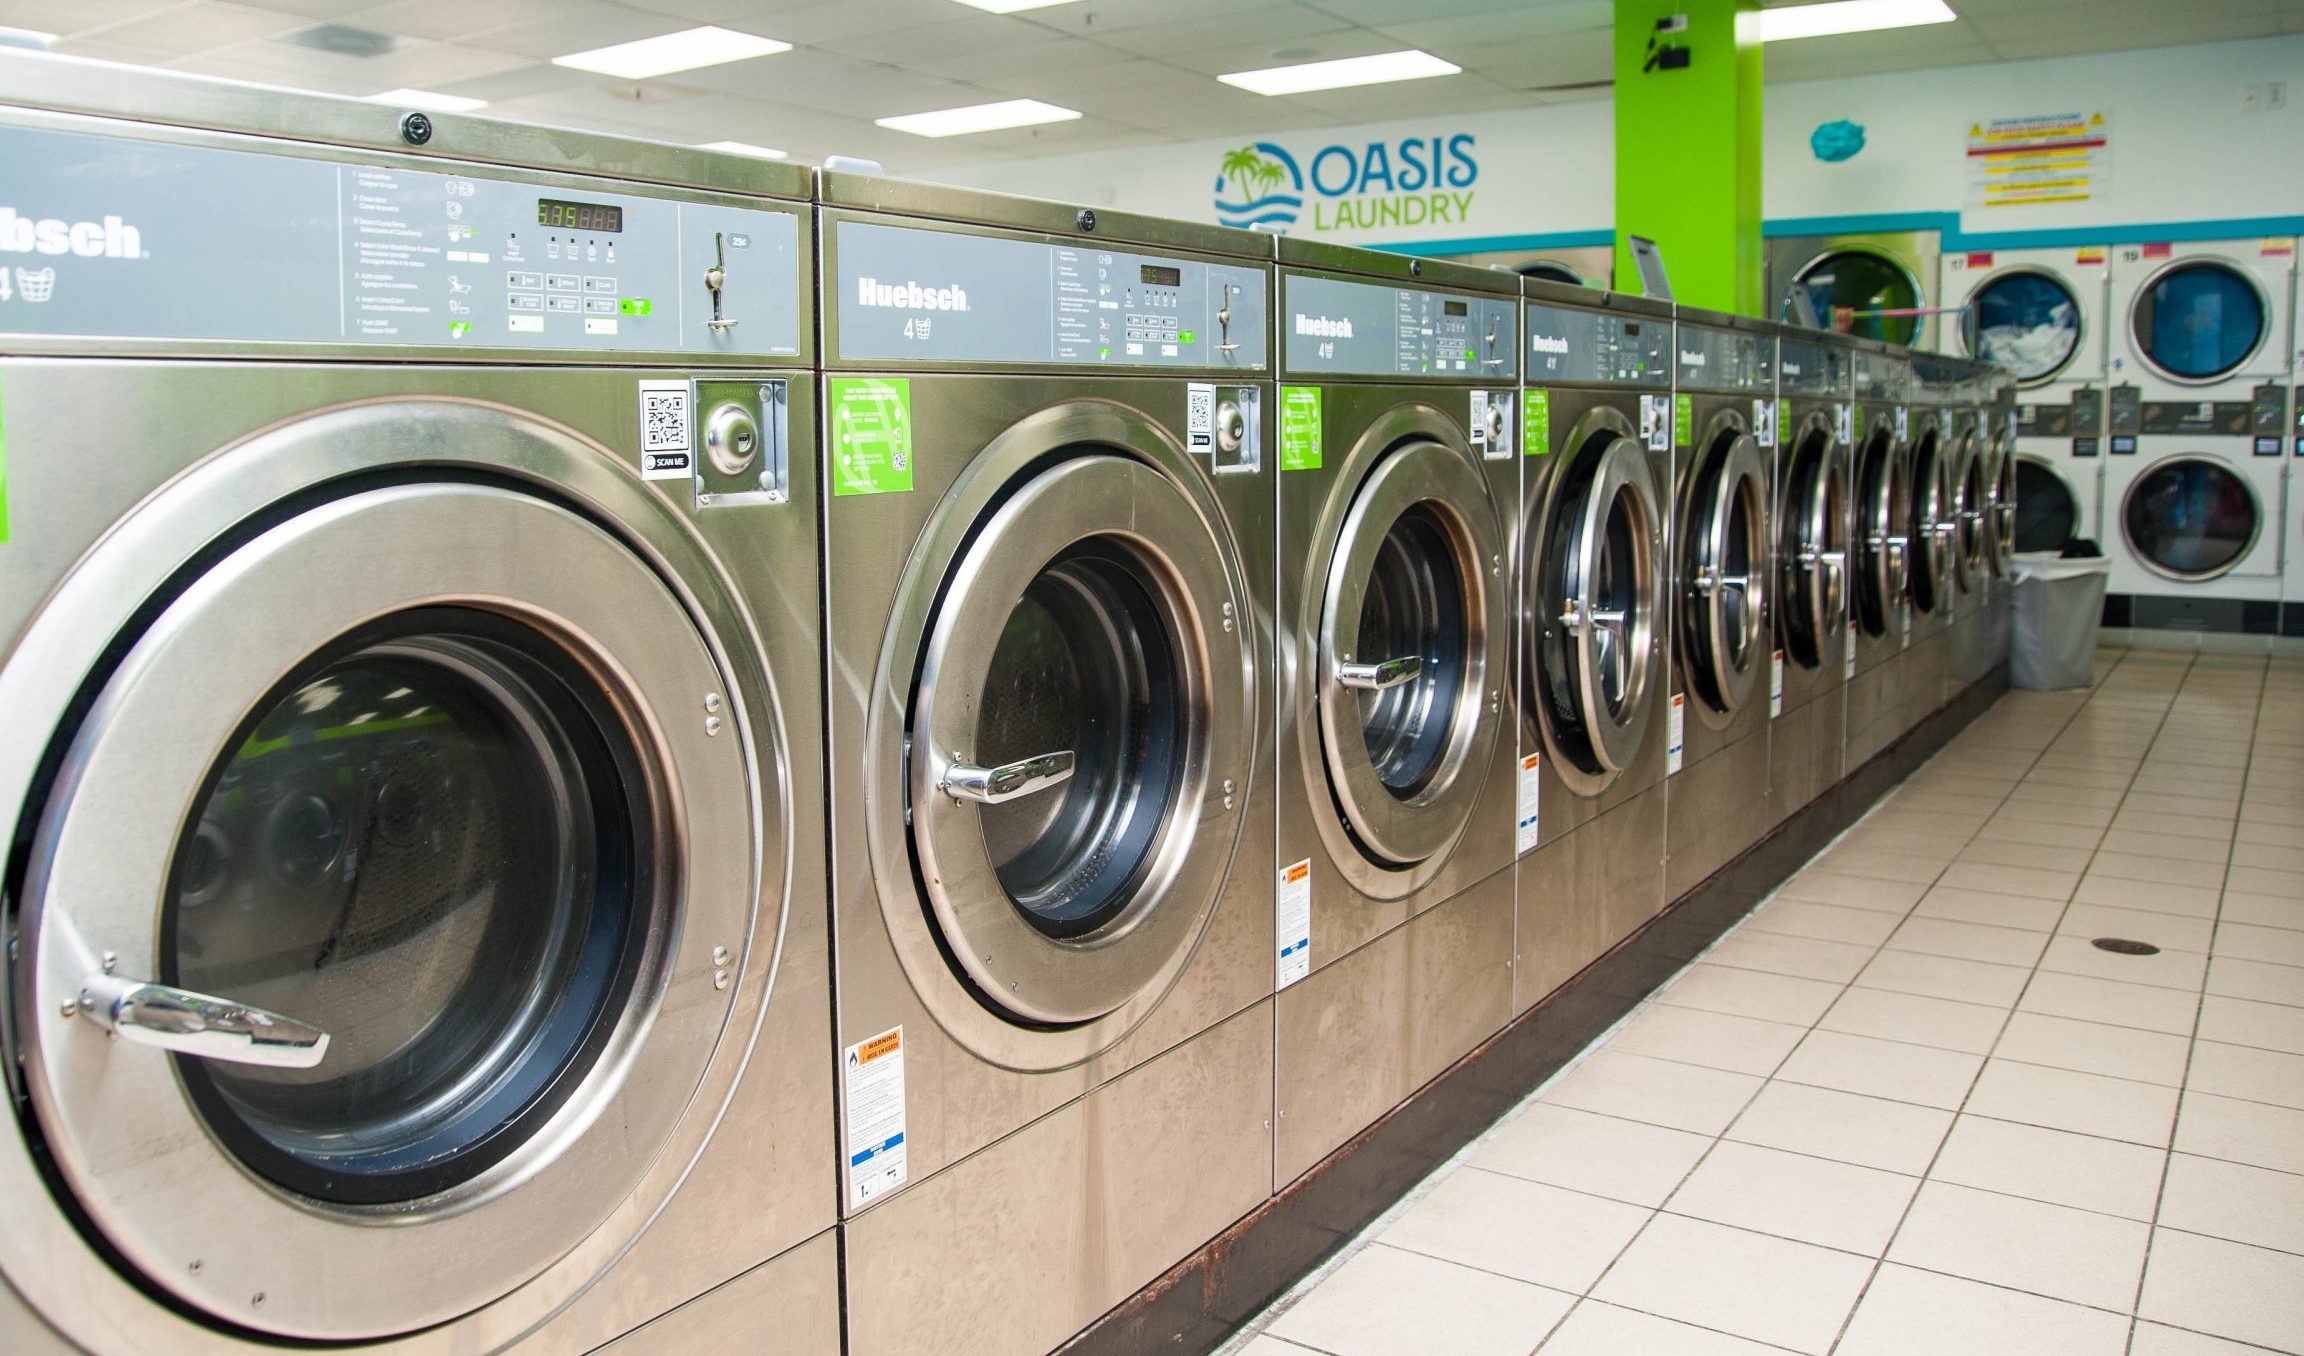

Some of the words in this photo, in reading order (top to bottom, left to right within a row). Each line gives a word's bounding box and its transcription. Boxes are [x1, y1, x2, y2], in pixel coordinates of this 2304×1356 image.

[1311, 133, 1478, 197] OASIS
[1314, 191, 1474, 231] LAUNDRY
[859, 277, 967, 311] Huebsch
[904, 318, 914, 339] 4
[1295, 313, 1352, 338] Huebsch
[657, 458, 673, 466] SCAN
[674, 458, 684, 466] ME
[868, 1032, 897, 1050] WARNING
